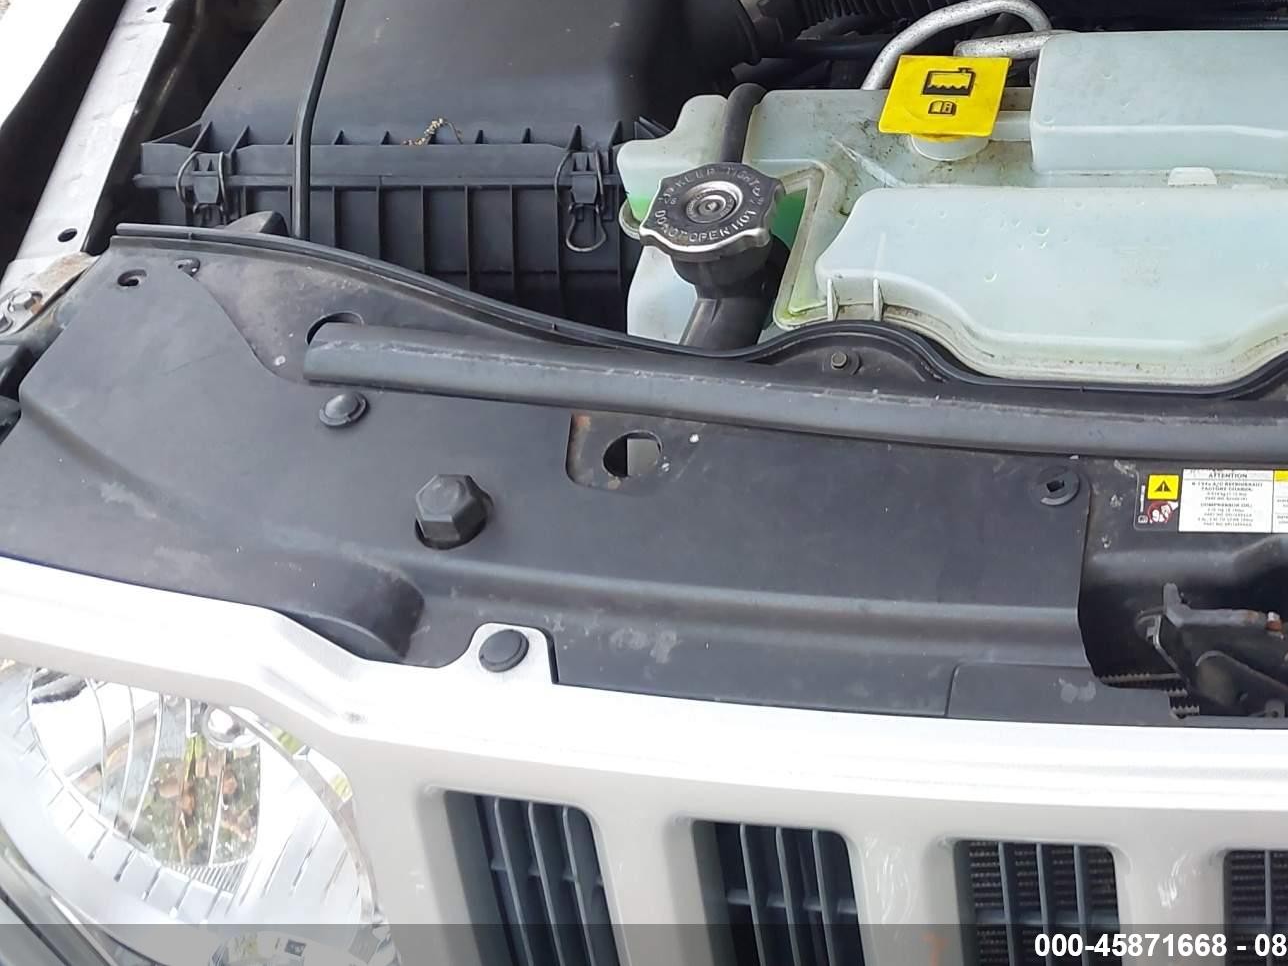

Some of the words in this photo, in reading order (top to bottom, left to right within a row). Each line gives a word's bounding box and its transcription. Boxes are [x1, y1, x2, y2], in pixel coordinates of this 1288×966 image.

[654, 209, 668, 225] DO
[661, 223, 688, 238] NOT
[688, 228, 731, 243] OPEN
[731, 210, 757, 231] HOT
